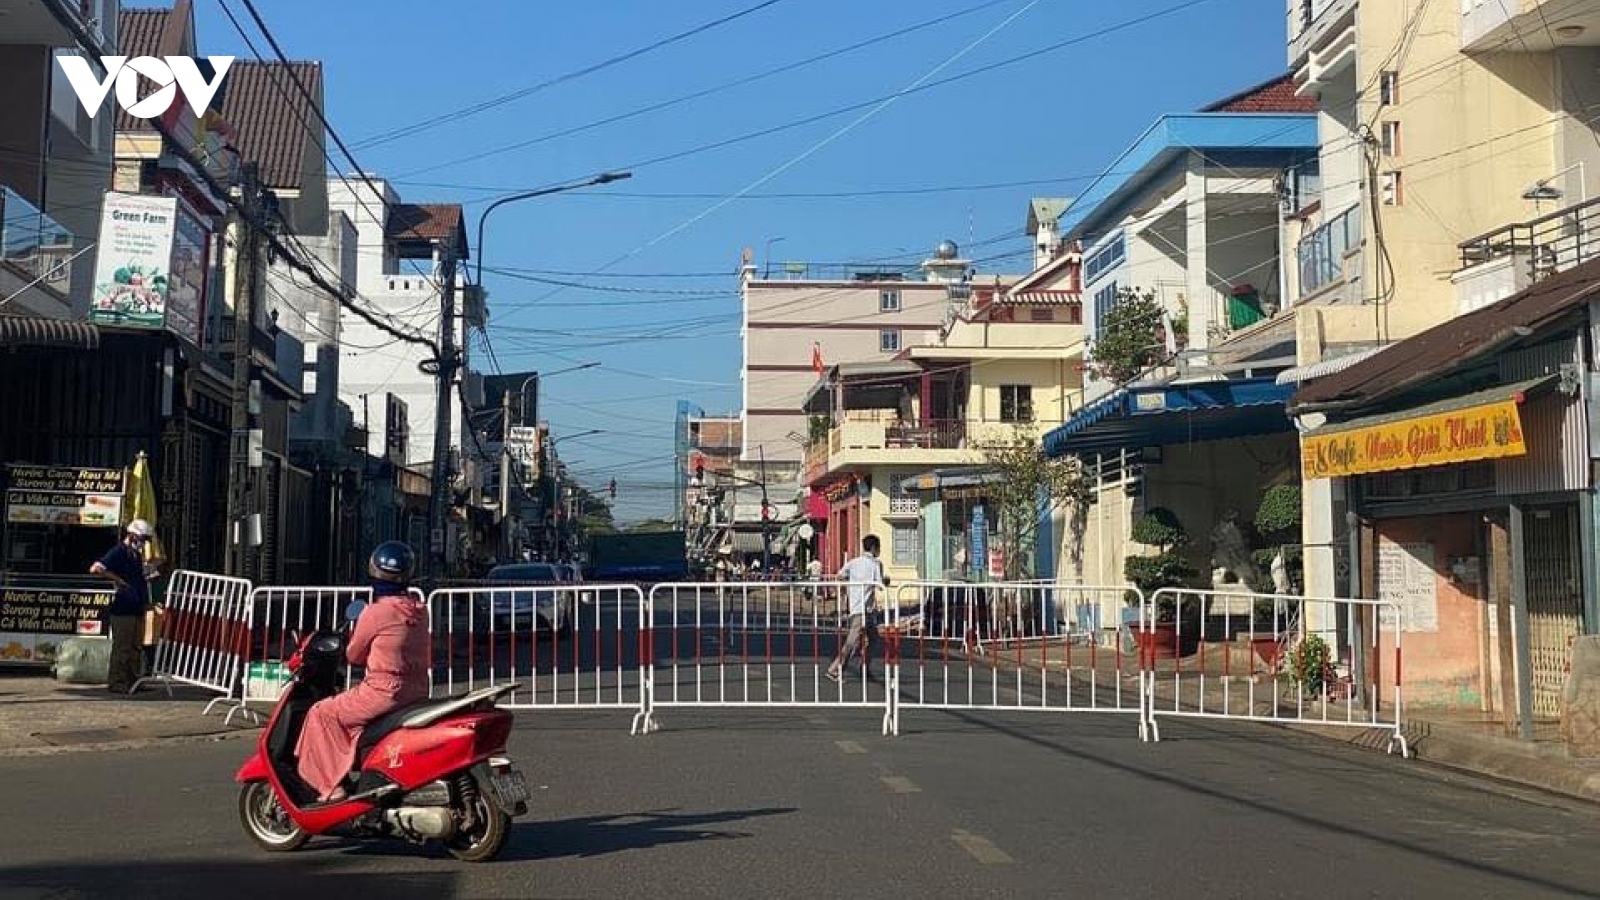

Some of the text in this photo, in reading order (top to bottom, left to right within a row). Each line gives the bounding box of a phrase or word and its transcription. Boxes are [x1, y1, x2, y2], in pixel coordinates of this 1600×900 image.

[112, 209, 167, 224] Green Farm
[78, 470, 101, 480] Rau
[68, 593, 92, 603] Rau
[93, 594, 110, 605] Má
